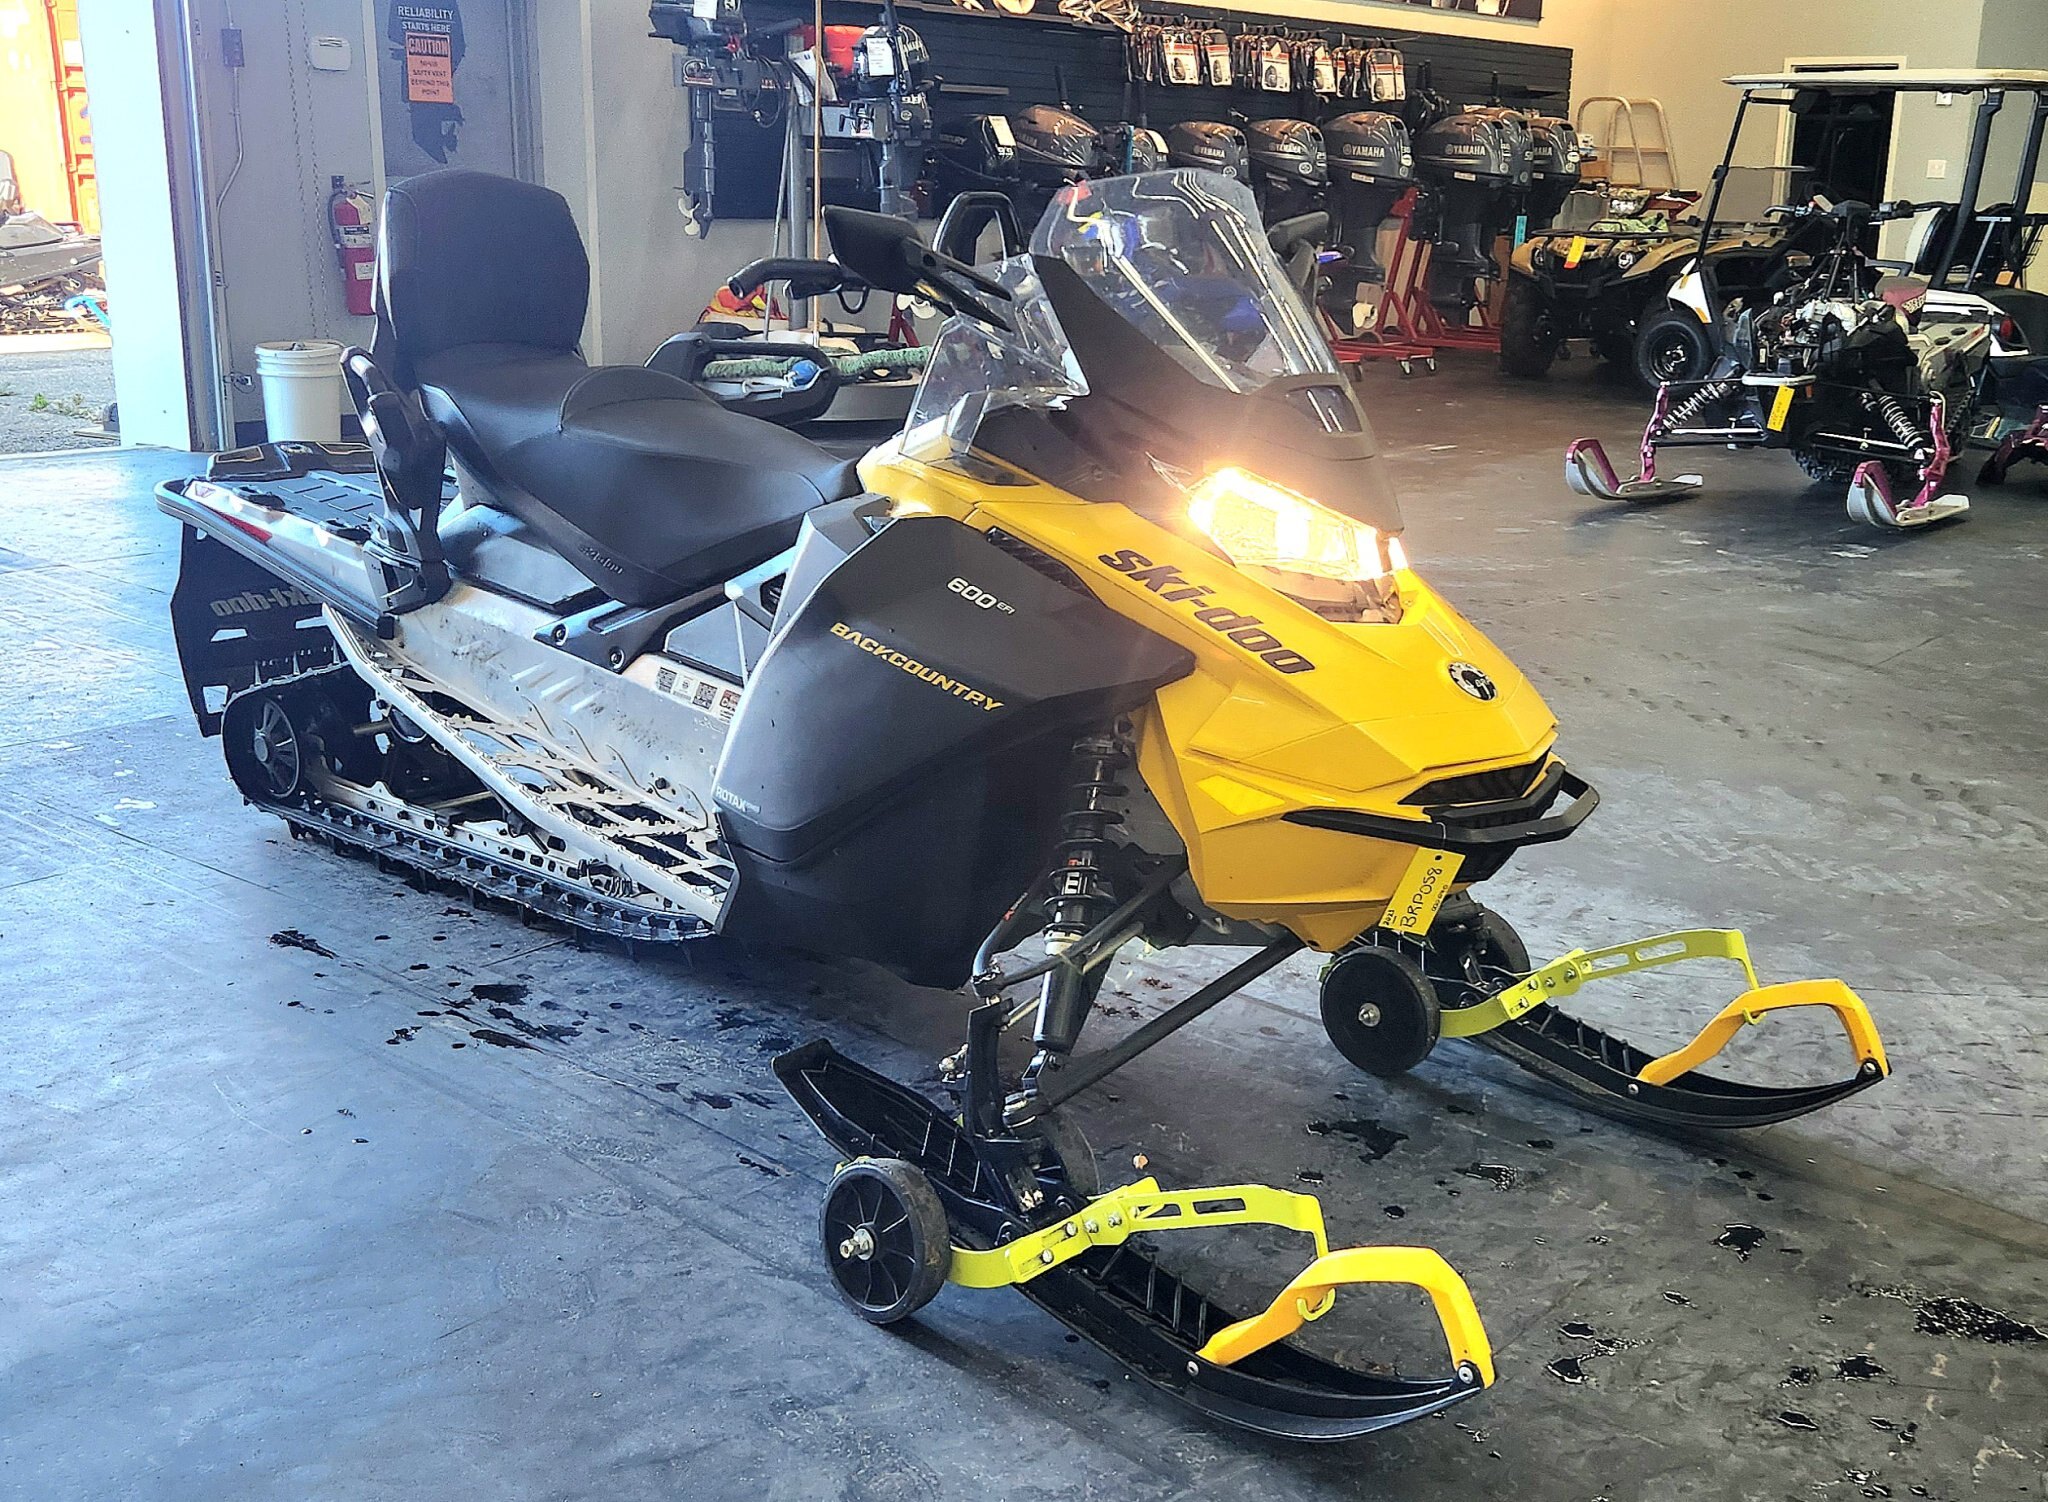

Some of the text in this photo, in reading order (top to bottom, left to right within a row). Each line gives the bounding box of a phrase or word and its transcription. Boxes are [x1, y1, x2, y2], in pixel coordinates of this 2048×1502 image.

[397, 6, 454, 20] RELIABILITY
[402, 21, 451, 33] STARTS HERE
[408, 38, 449, 56] CAUTION
[1352, 145, 1385, 158] YAMAHA
[1453, 144, 1486, 156] YAMAHA
[947, 577, 1015, 616] 600 EFI
[829, 622, 1005, 711] BACKCOUNTRY
[715, 785, 746, 813] ROTAX
